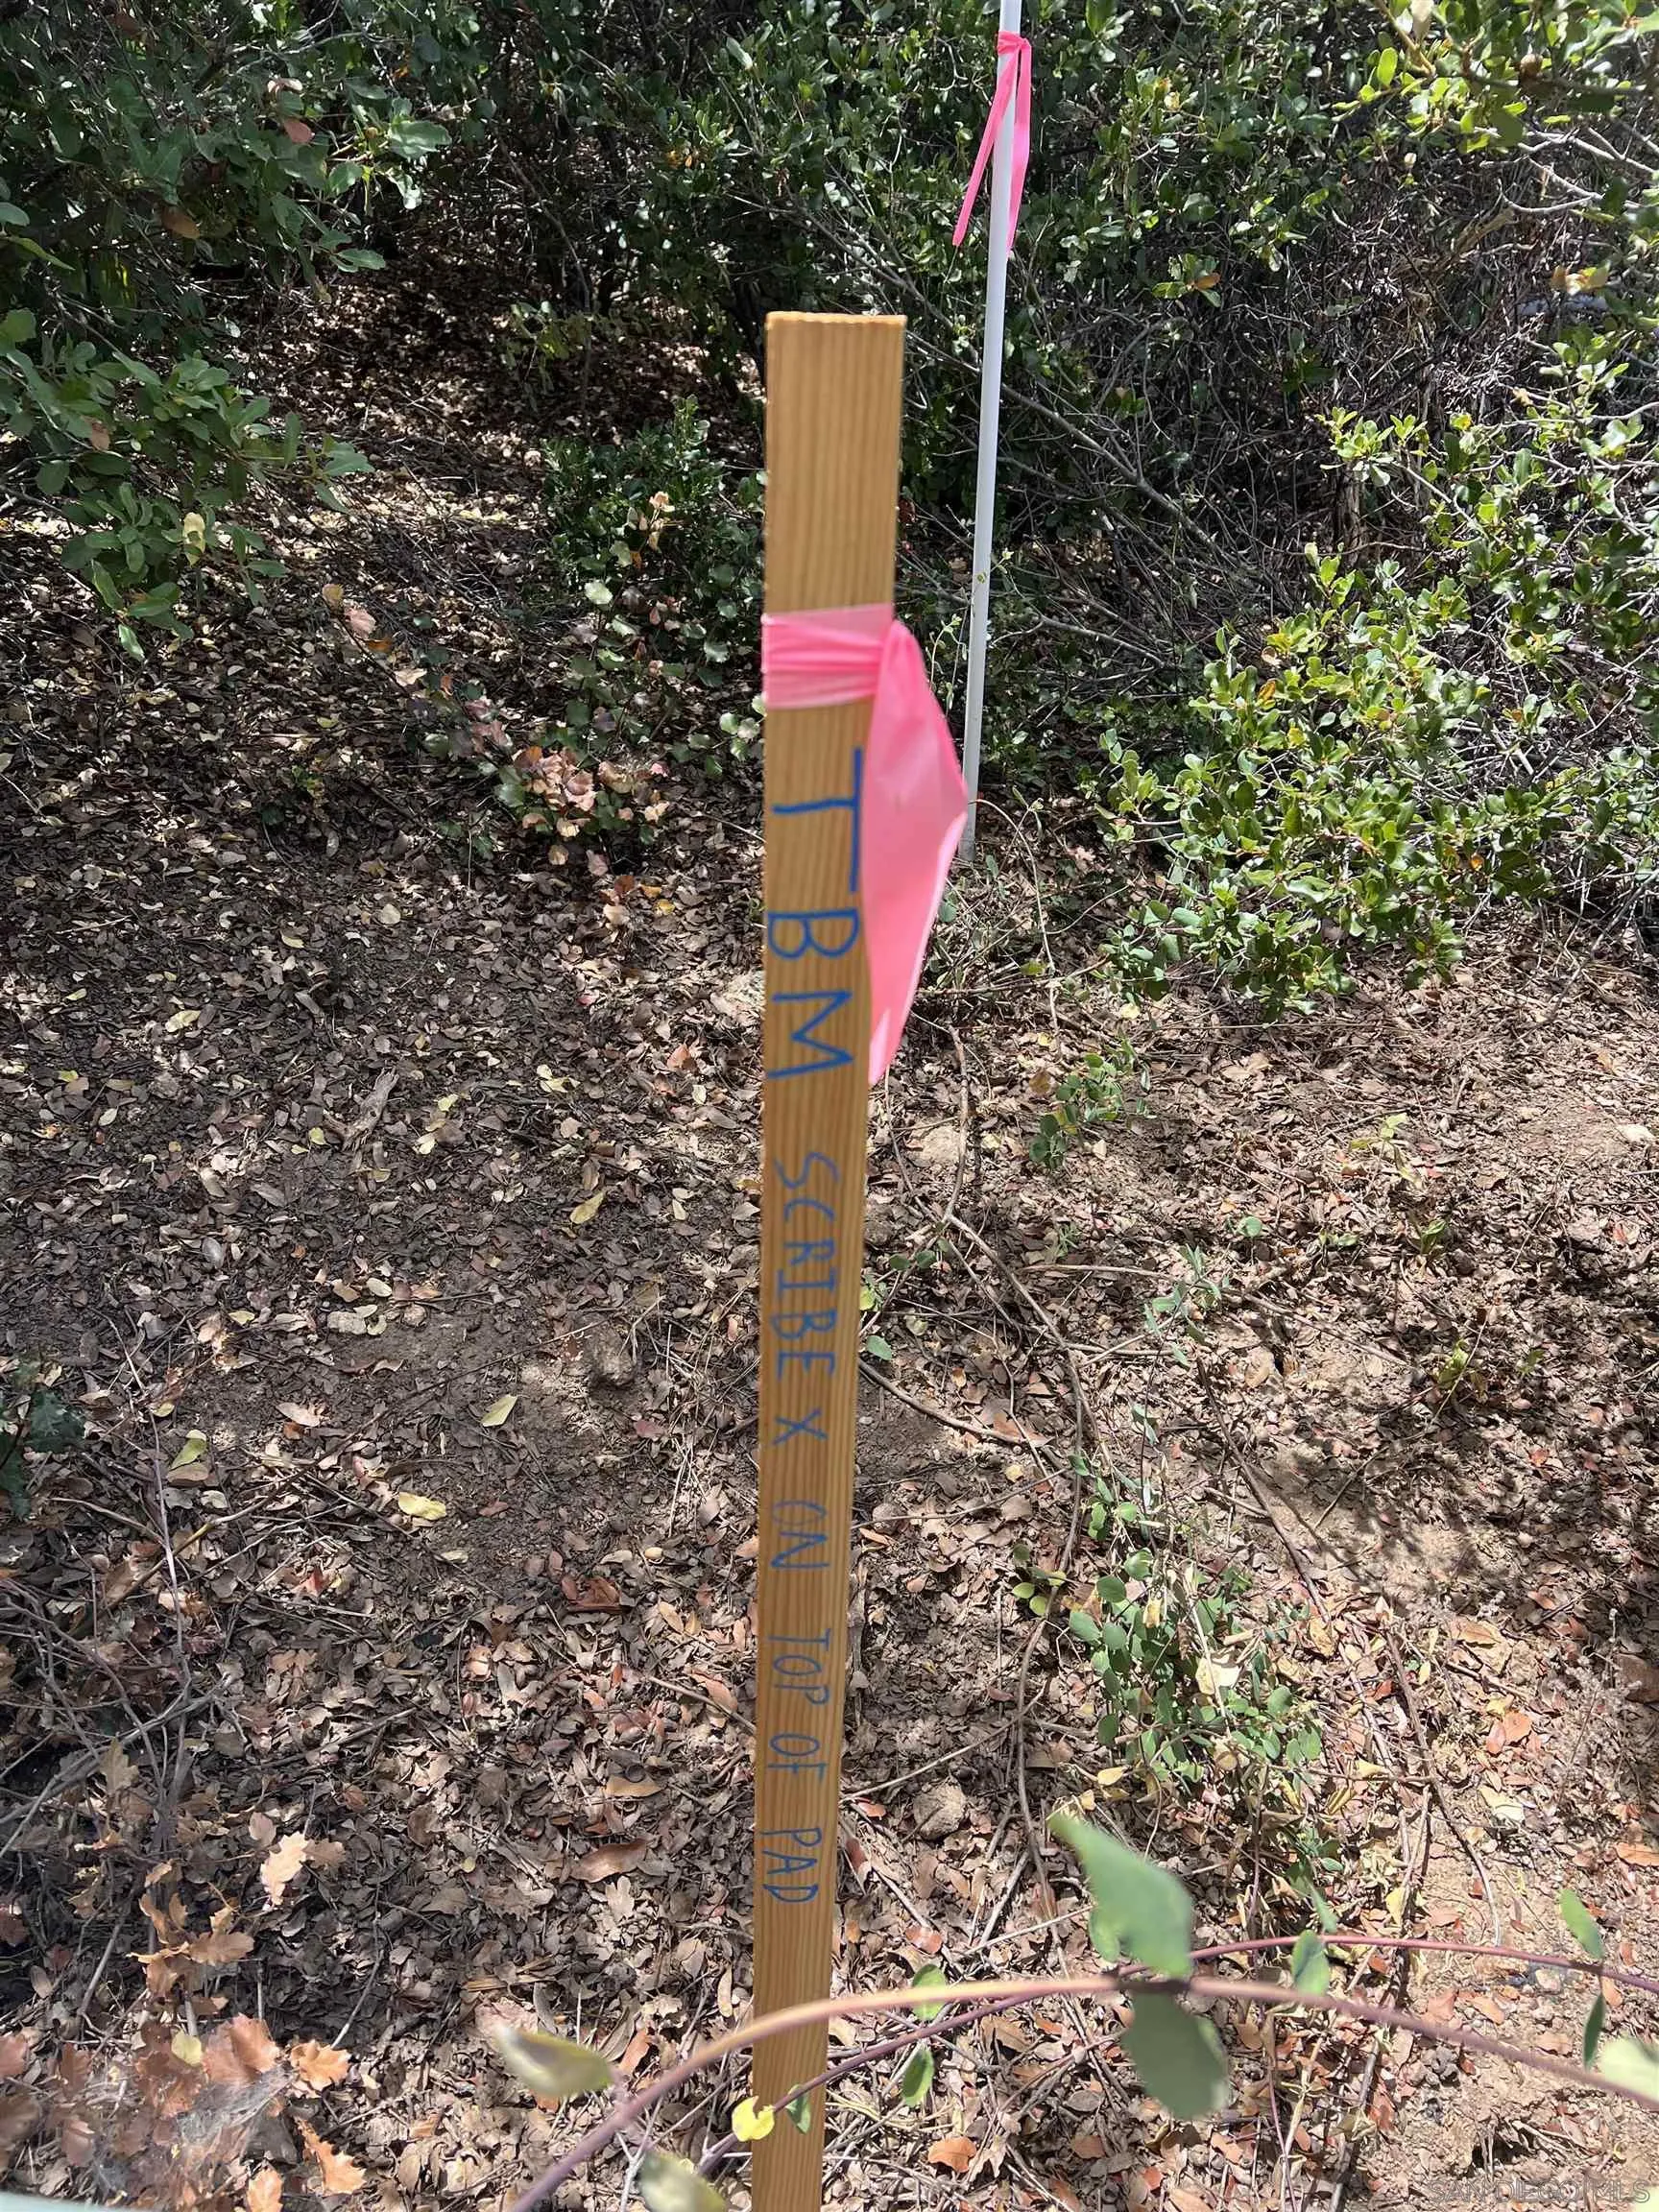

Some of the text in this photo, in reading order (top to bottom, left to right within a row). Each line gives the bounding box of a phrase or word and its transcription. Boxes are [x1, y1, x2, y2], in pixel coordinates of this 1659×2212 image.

[760, 747, 863, 1903] TBM SCRIBE X ON TOP OF PAD
